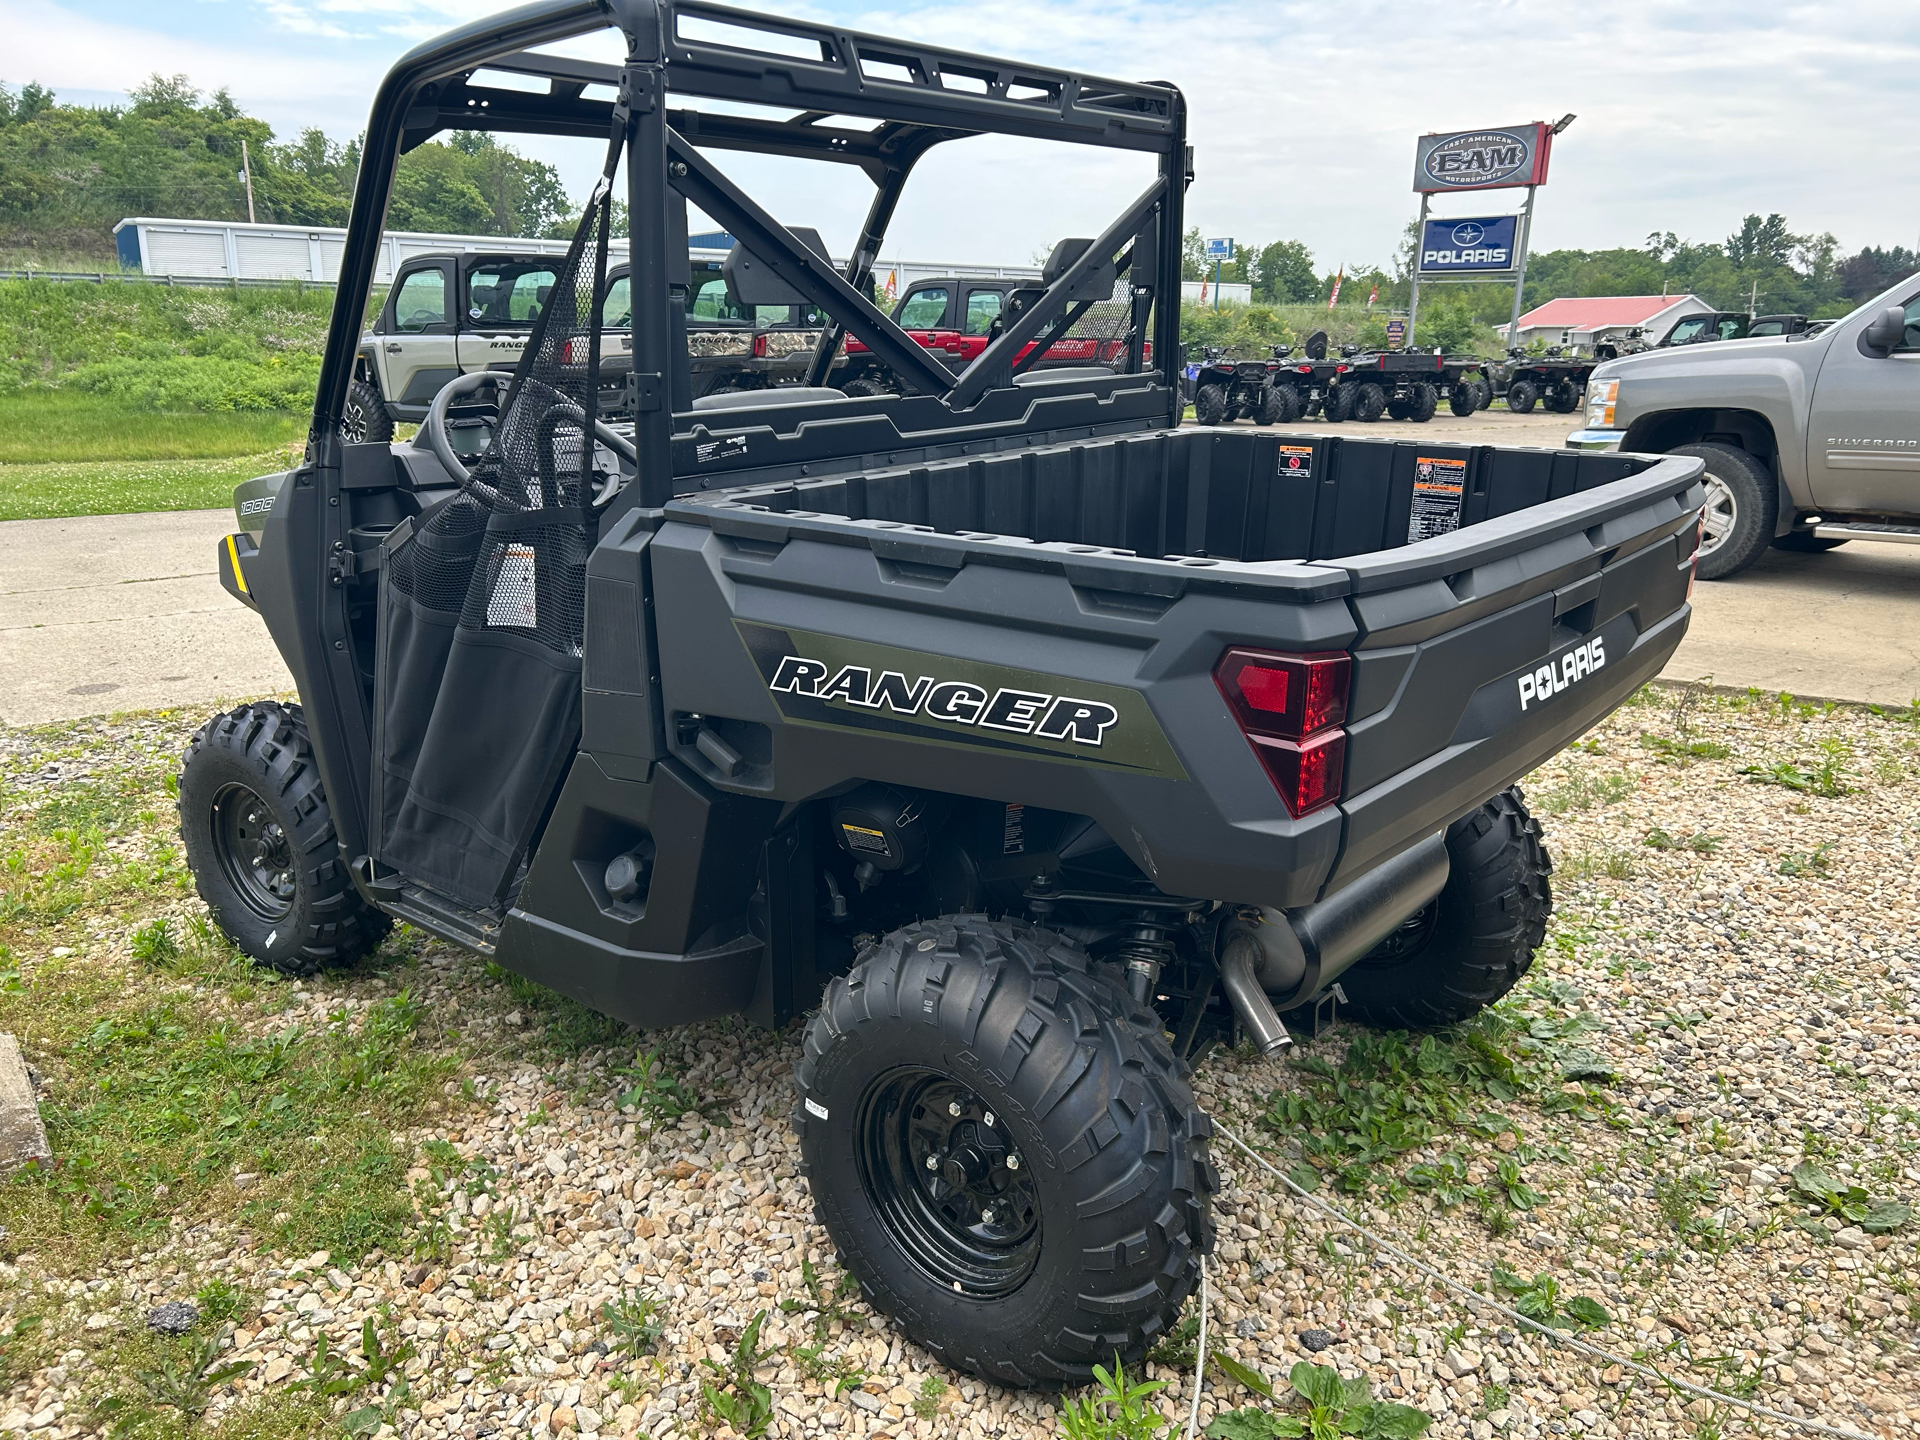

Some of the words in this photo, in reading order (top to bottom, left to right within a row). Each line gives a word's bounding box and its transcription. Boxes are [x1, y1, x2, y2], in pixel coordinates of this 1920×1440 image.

[1444, 138, 1466, 150] EAST
[1468, 134, 1512, 144] AMERICAN
[1445, 171, 1502, 183] MOTORSPORTS
[1424, 249, 1507, 264] POLARIS
[1827, 438, 1917, 447] SILVERADO
[1518, 636, 1605, 711] POLARIS
[770, 655, 1118, 746] RANGER
